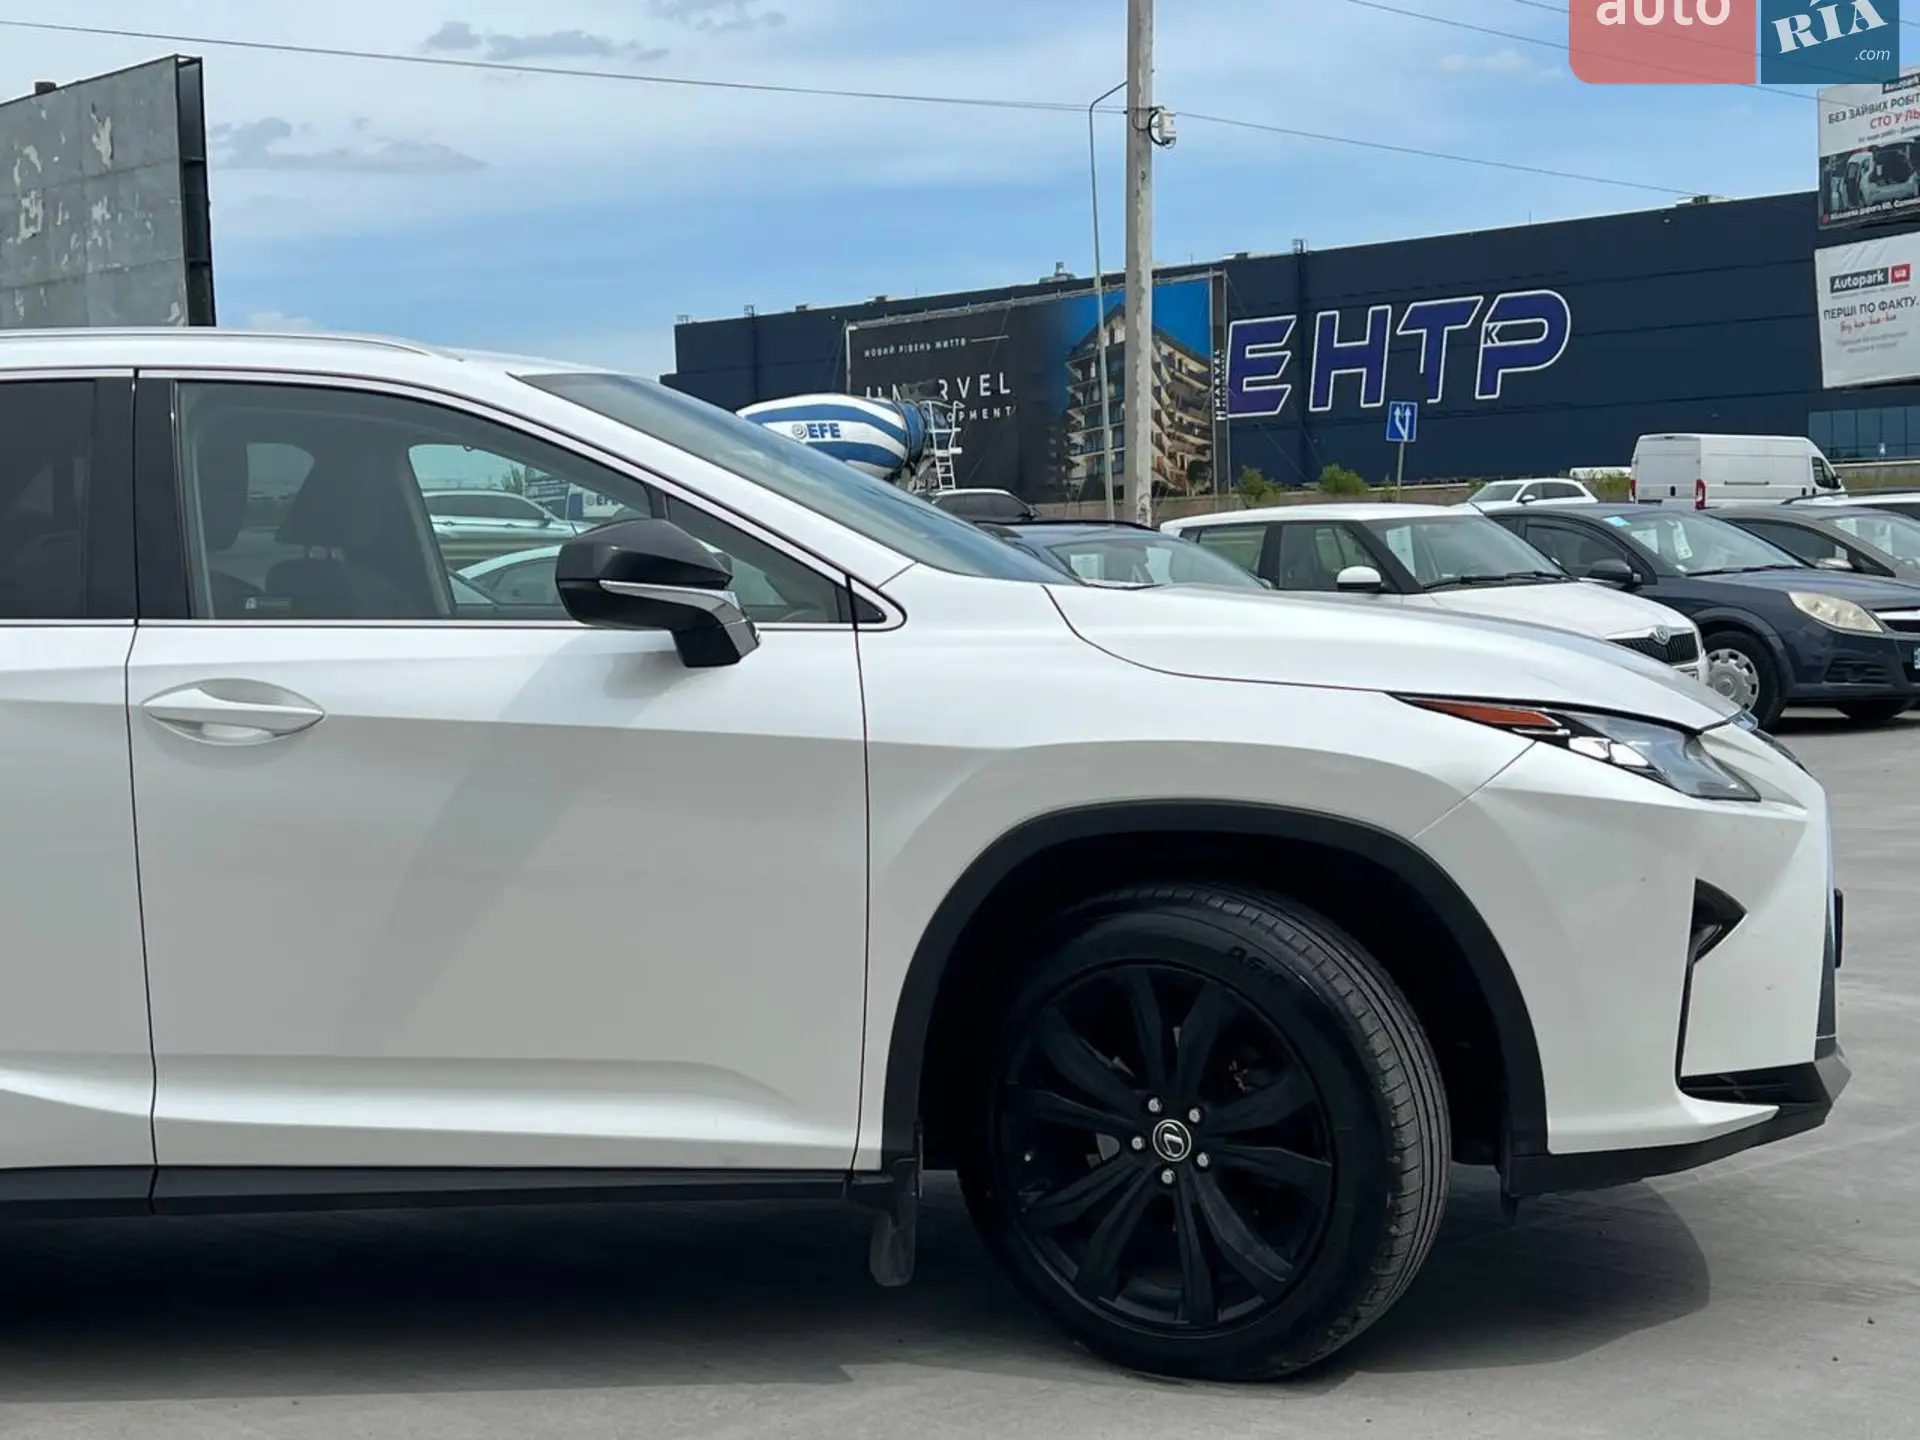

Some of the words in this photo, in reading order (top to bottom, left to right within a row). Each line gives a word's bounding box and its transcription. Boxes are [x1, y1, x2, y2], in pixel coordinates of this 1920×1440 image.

[1828, 111, 1847, 124] БЕЗ
[1870, 115, 1892, 129] СТО
[1833, 270, 1885, 290] Autopark
[1824, 304, 1857, 320] ПЕРШІ
[1860, 302, 1876, 314] ПО
[807, 423, 841, 439] EFE
